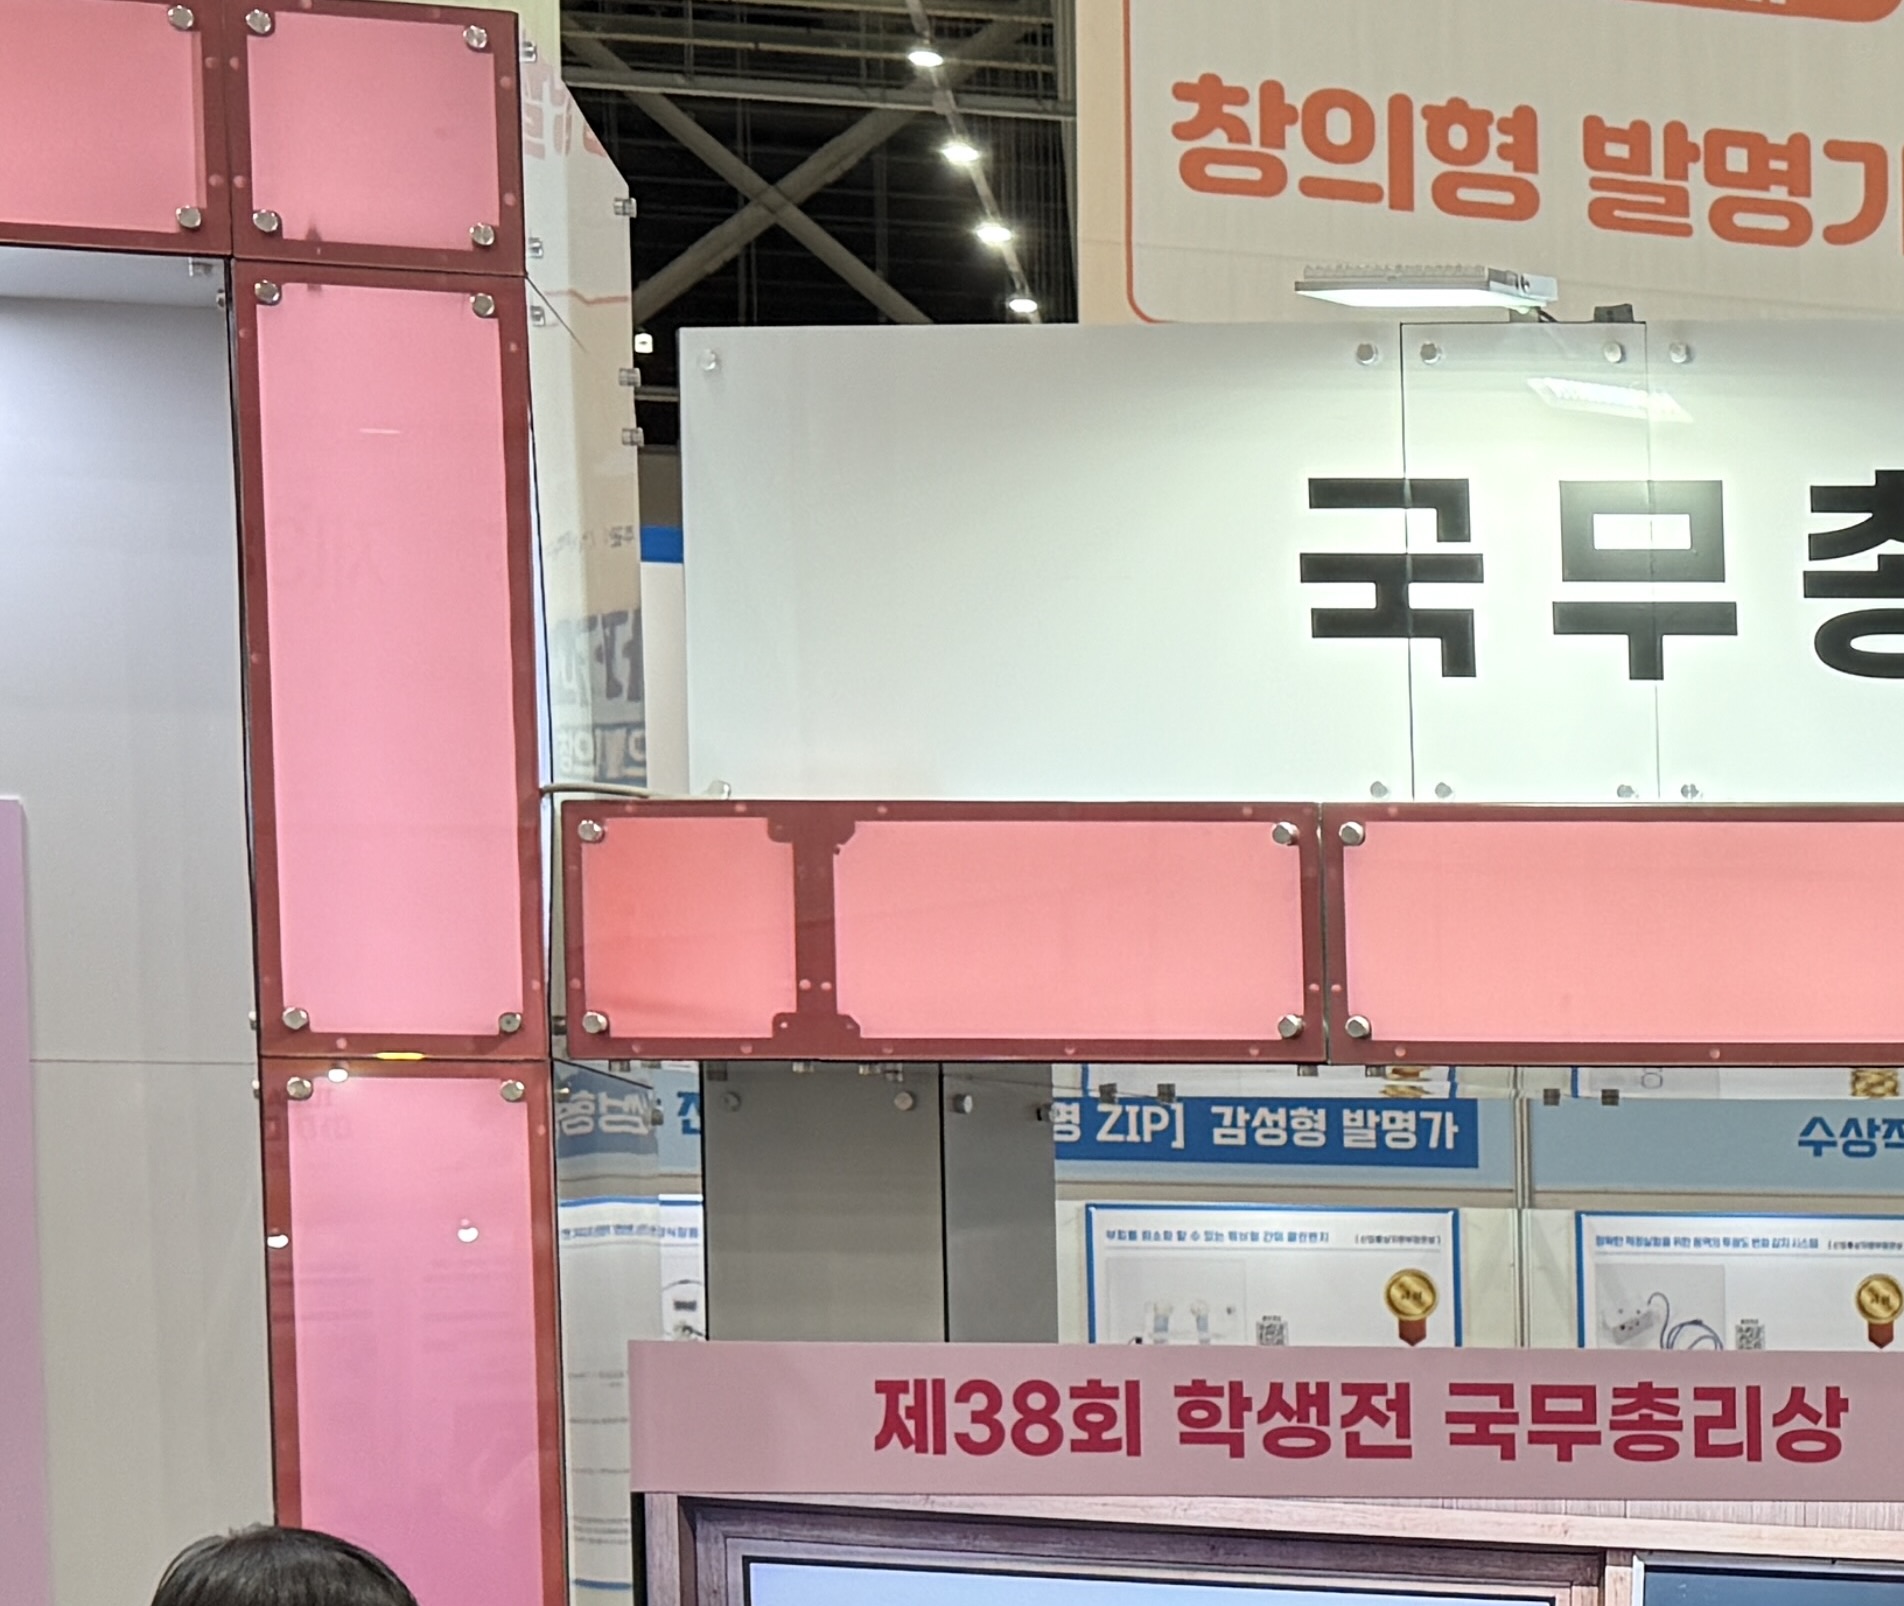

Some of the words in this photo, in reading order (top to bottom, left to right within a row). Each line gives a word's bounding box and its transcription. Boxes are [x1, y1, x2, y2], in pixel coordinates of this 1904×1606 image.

[1170, 72, 1540, 222] 창의형
[1052, 1102, 1081, 1142] 명
[1096, 1102, 1185, 1149] ZIP]
[1210, 1104, 1327, 1147] 감성형
[1341, 1108, 1459, 1150] 발명가
[873, 1377, 1144, 1458] 제38회
[1174, 1379, 1416, 1464] 학생전
[1443, 1382, 1851, 1467] 국무총리상
